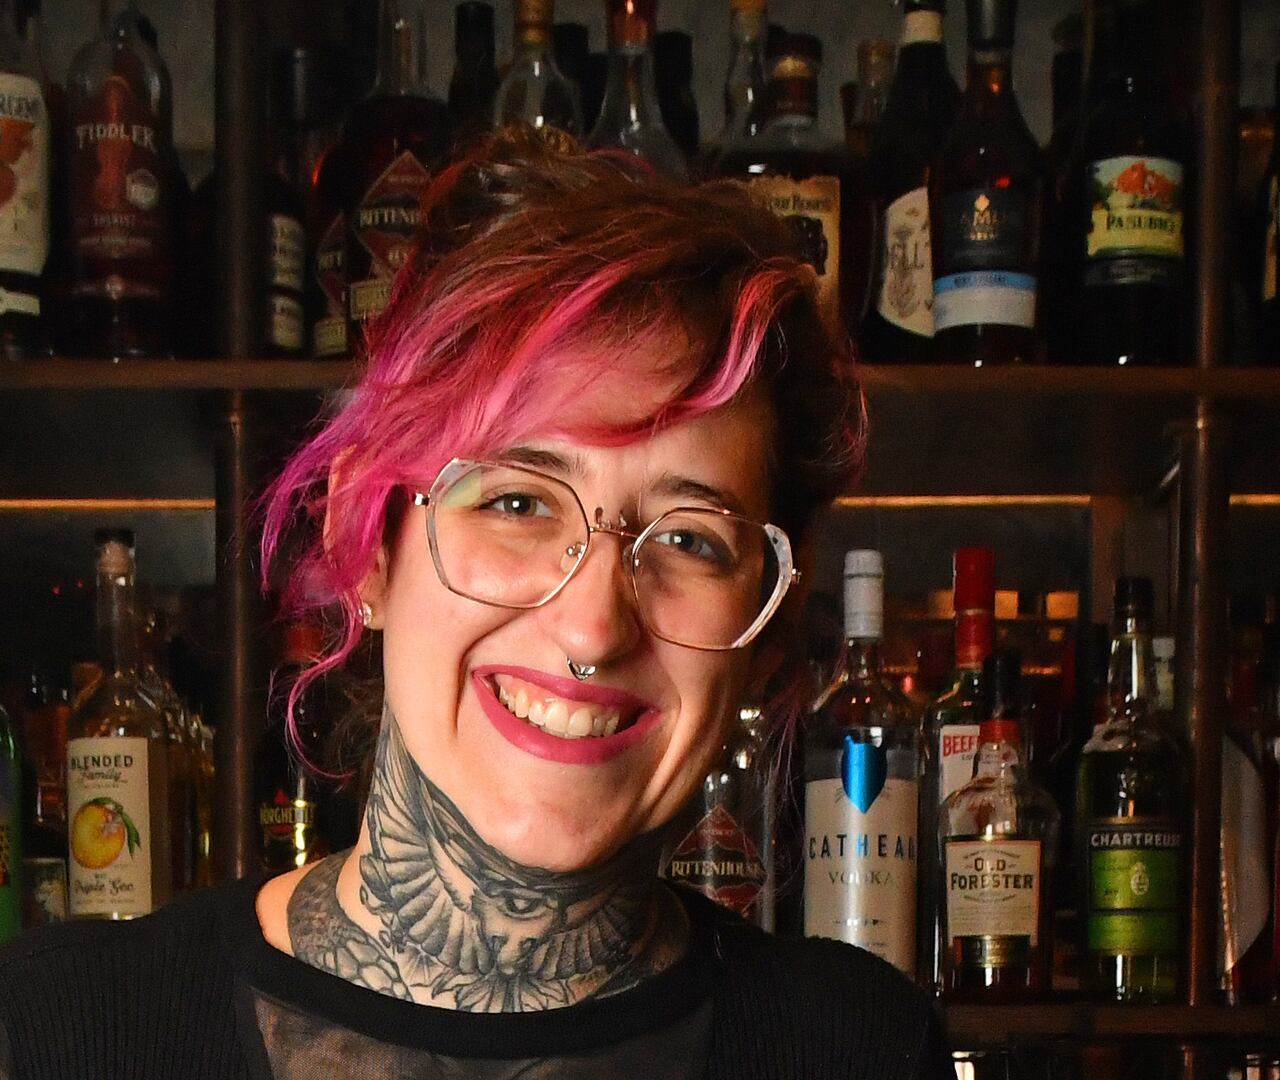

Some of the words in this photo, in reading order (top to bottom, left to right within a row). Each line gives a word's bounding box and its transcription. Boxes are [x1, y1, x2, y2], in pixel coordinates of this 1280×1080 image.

[76, 124, 156, 152] FIDDLER
[359, 205, 426, 226] RITTEN
[942, 735, 980, 758] BEEF
[70, 754, 134, 770] BLENDED
[1090, 831, 1184, 847] CHARTREUS
[671, 861, 762, 880] RITTENHOUSE
[951, 872, 1033, 890] FORESTER
